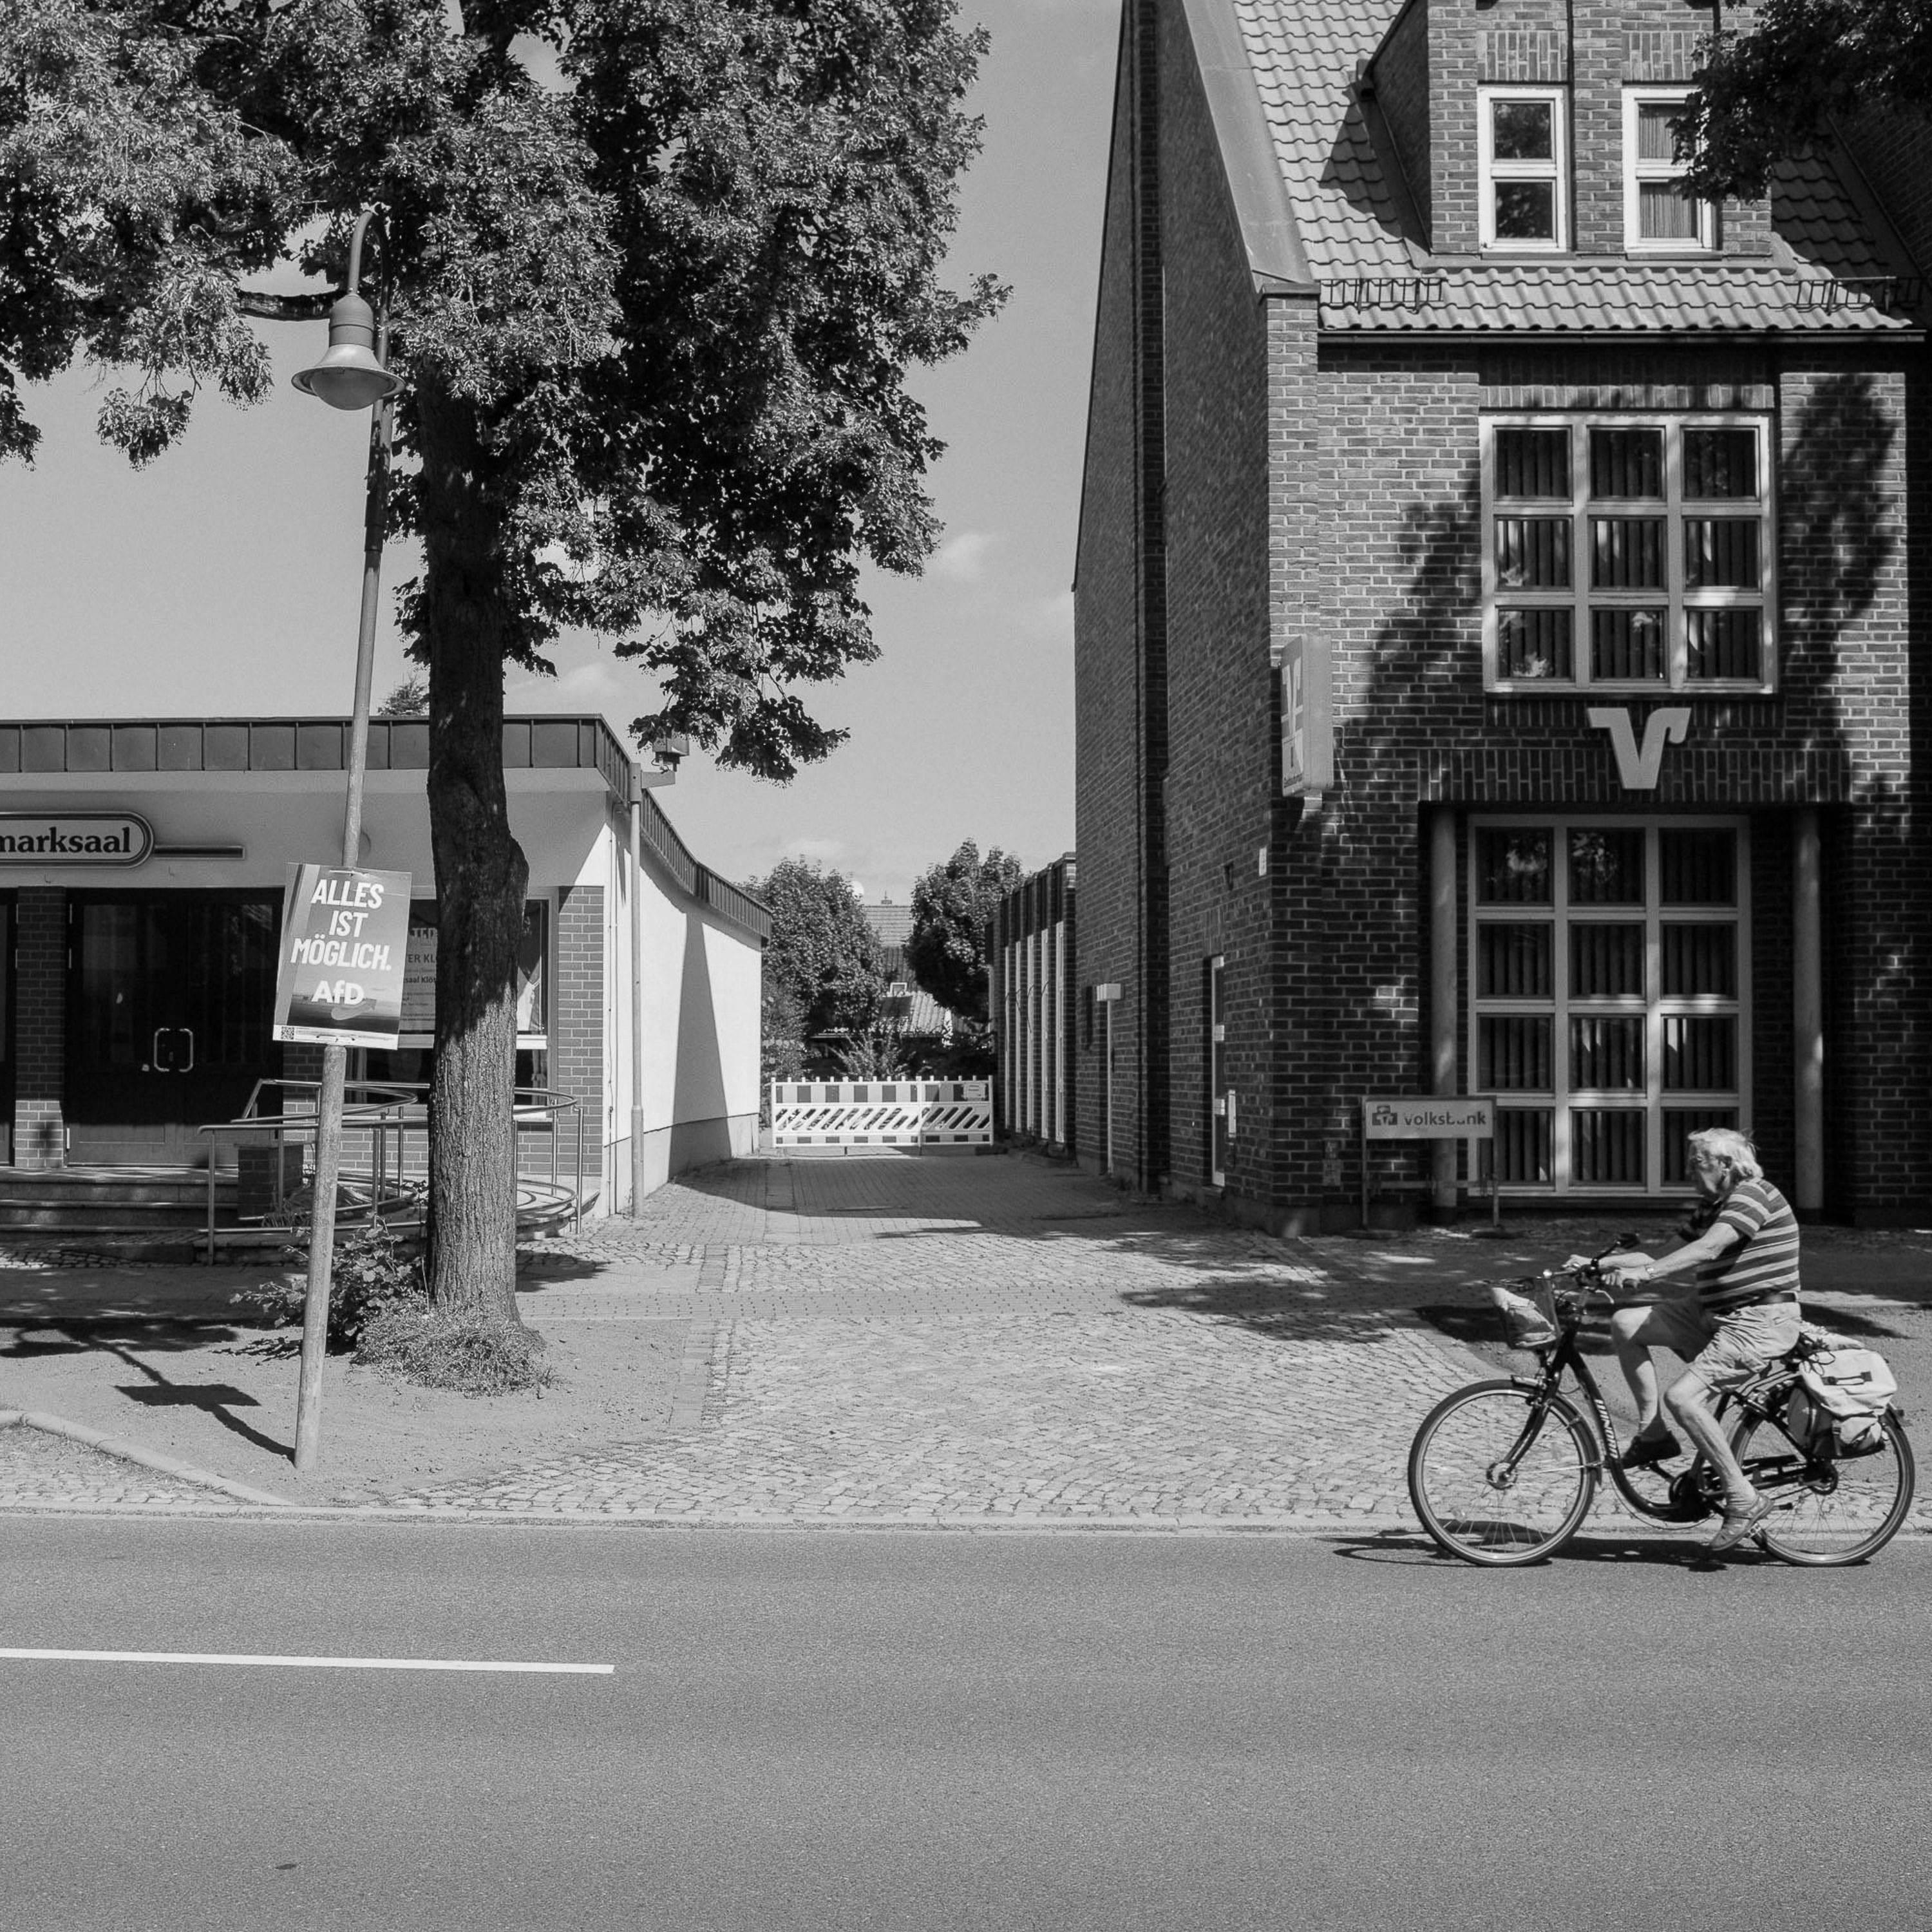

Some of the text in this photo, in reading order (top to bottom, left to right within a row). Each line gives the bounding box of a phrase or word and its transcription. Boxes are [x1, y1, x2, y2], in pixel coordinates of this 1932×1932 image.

[310, 878, 384, 909] ALLES
[329, 910, 369, 938] IST
[290, 934, 392, 971] MÖGLICH.
[408, 954, 435, 963] ER KL
[404, 975, 419, 983] saal
[311, 980, 365, 1005] AfD
